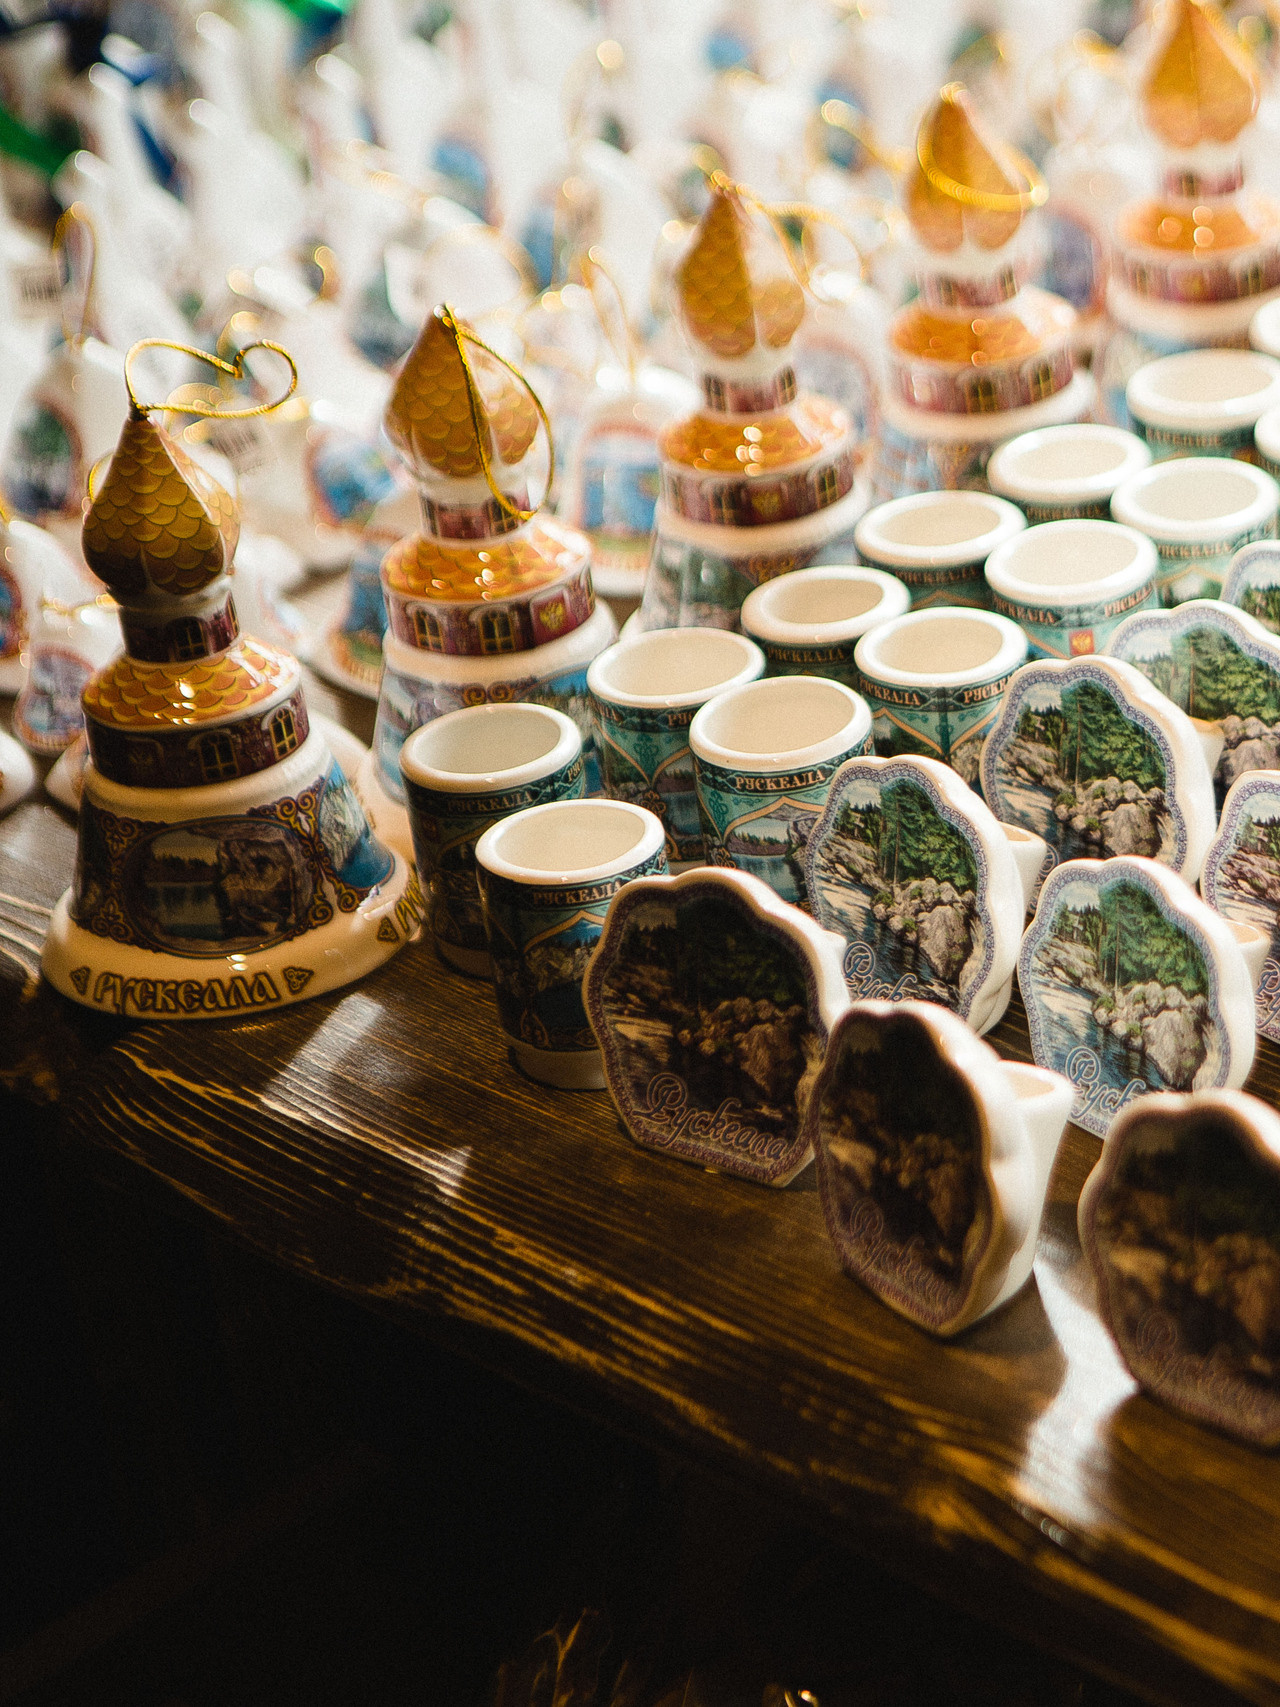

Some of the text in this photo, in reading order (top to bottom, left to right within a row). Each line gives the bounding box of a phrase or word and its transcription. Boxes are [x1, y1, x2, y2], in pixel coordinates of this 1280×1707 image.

[735, 769, 826, 791] РУСКЕАЛА
[532, 879, 623, 905] РУСКЕАЛА
[94, 971, 281, 1016] РУСКЕАЛА
[631, 1072, 788, 1160] Рускеала
